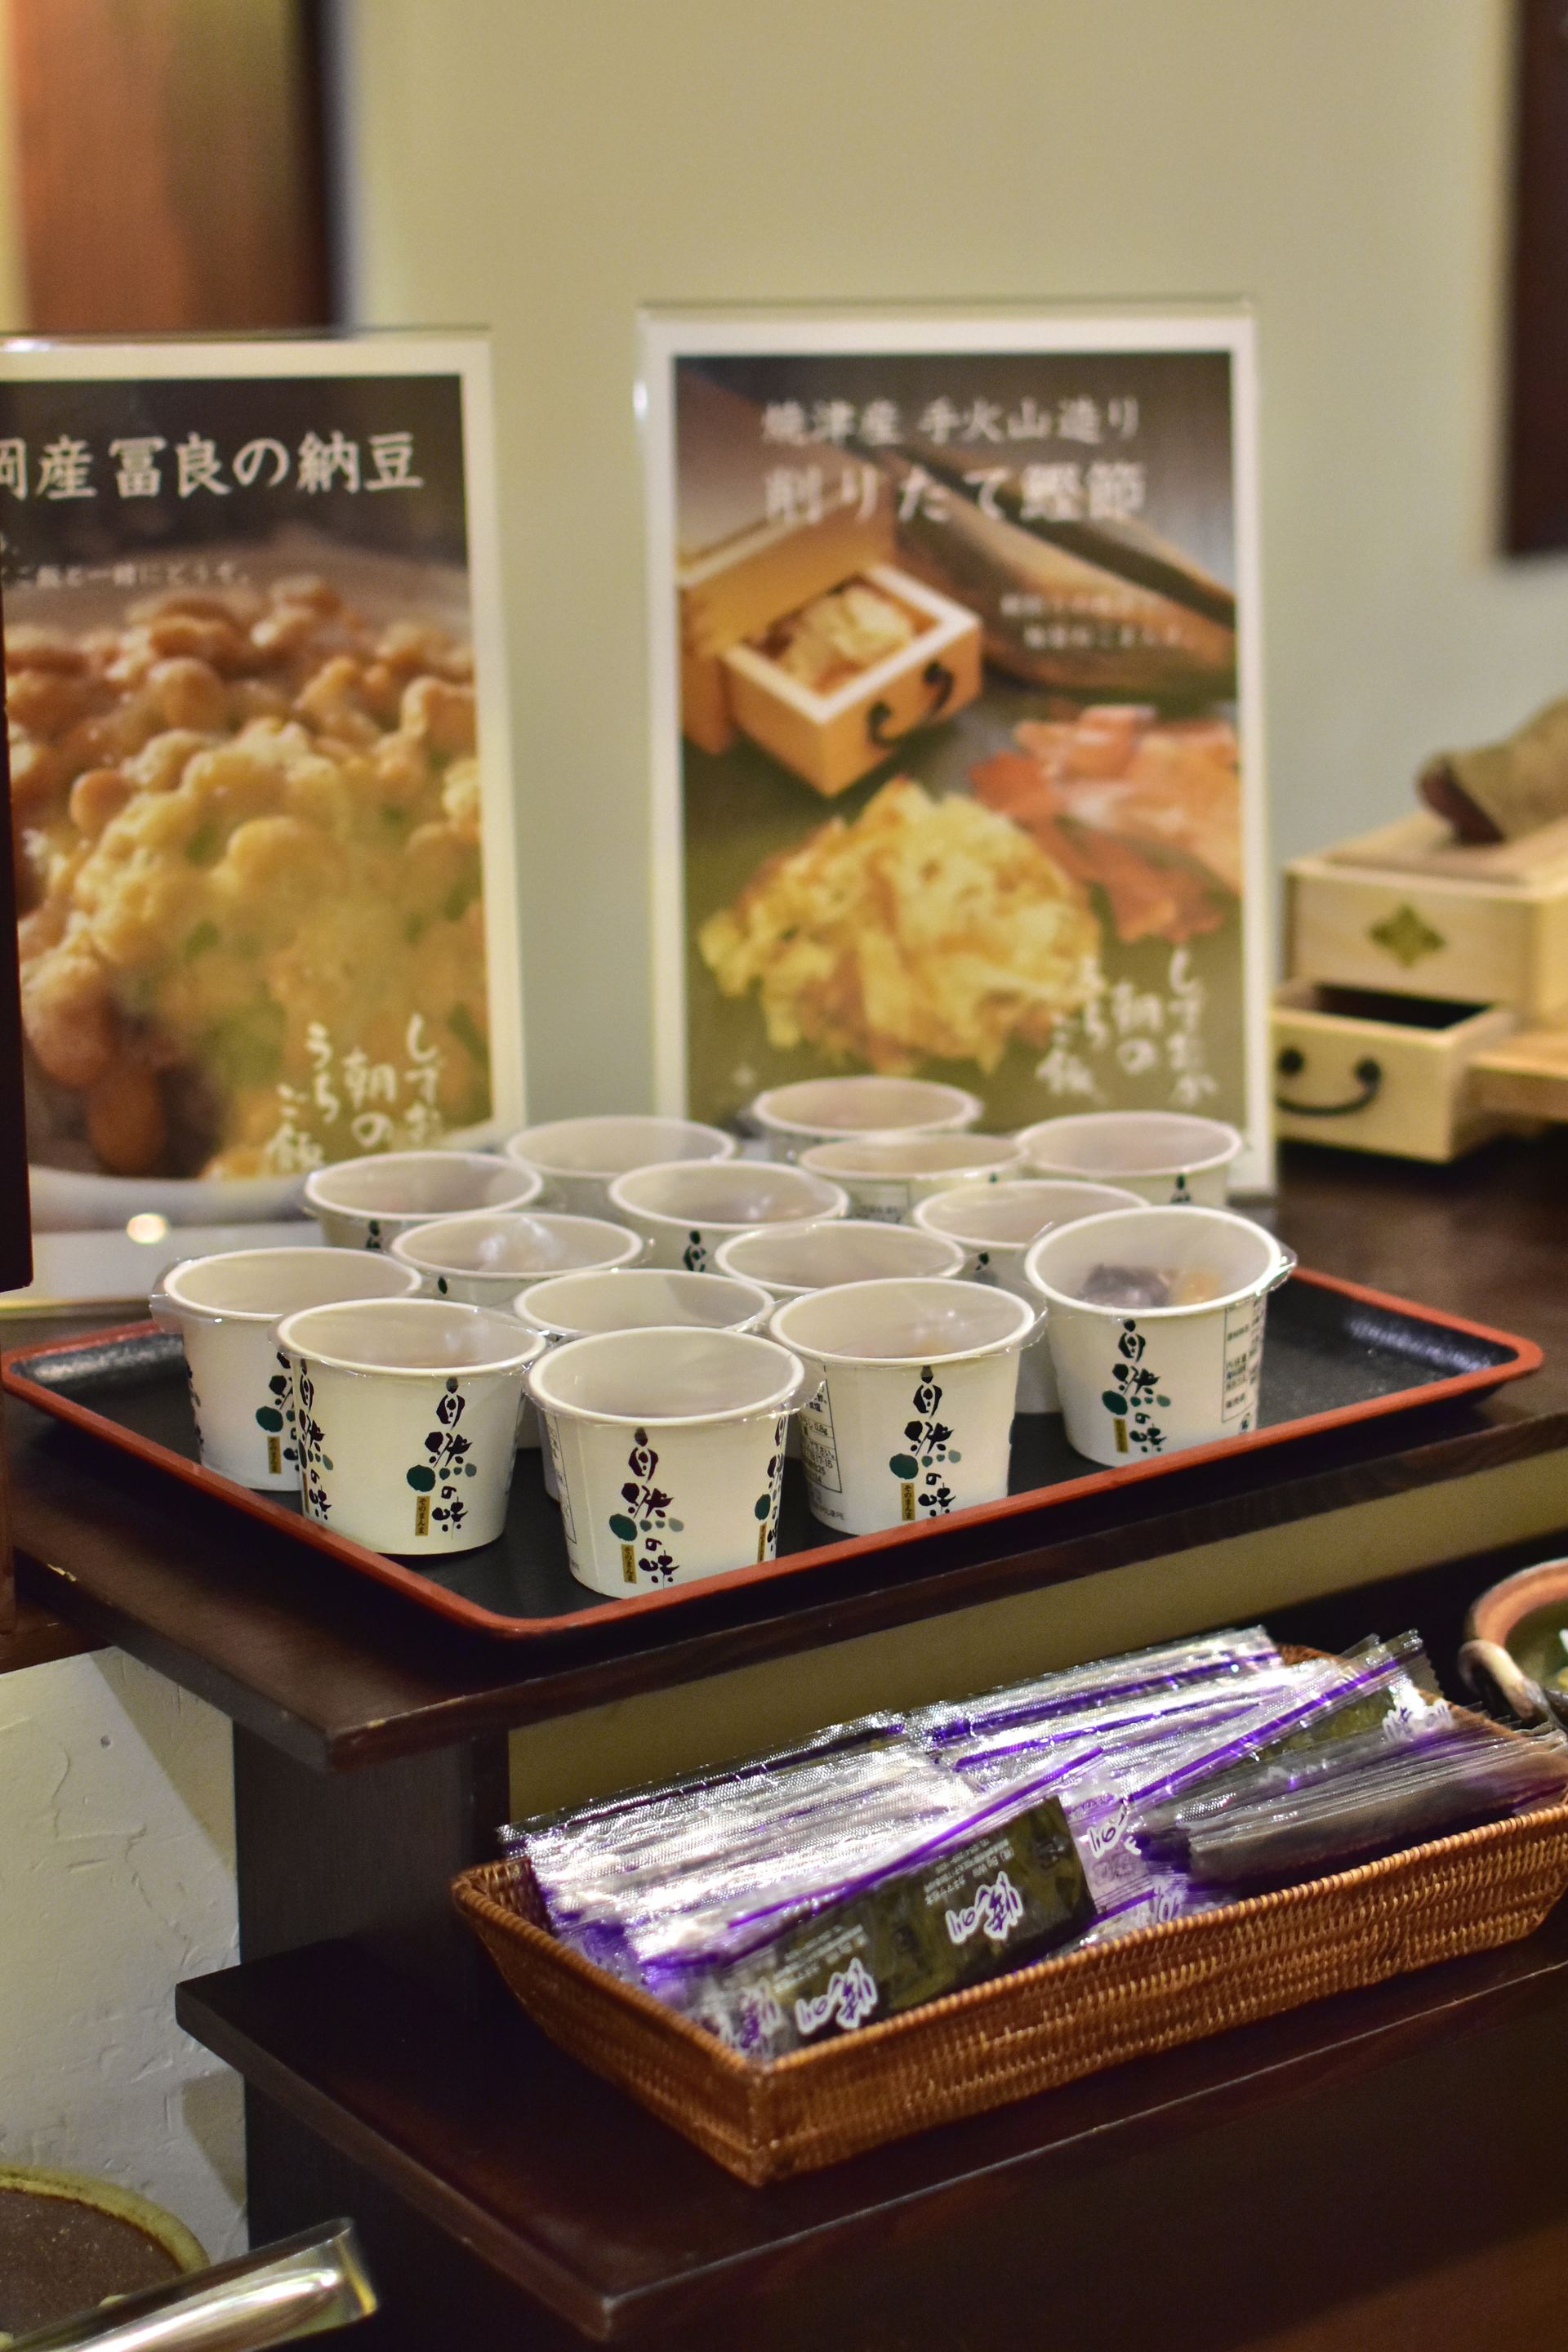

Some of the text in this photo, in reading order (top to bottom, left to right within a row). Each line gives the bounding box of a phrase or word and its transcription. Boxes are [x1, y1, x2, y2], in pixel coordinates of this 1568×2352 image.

[764, 461, 1145, 524] 削りたて鰹節
